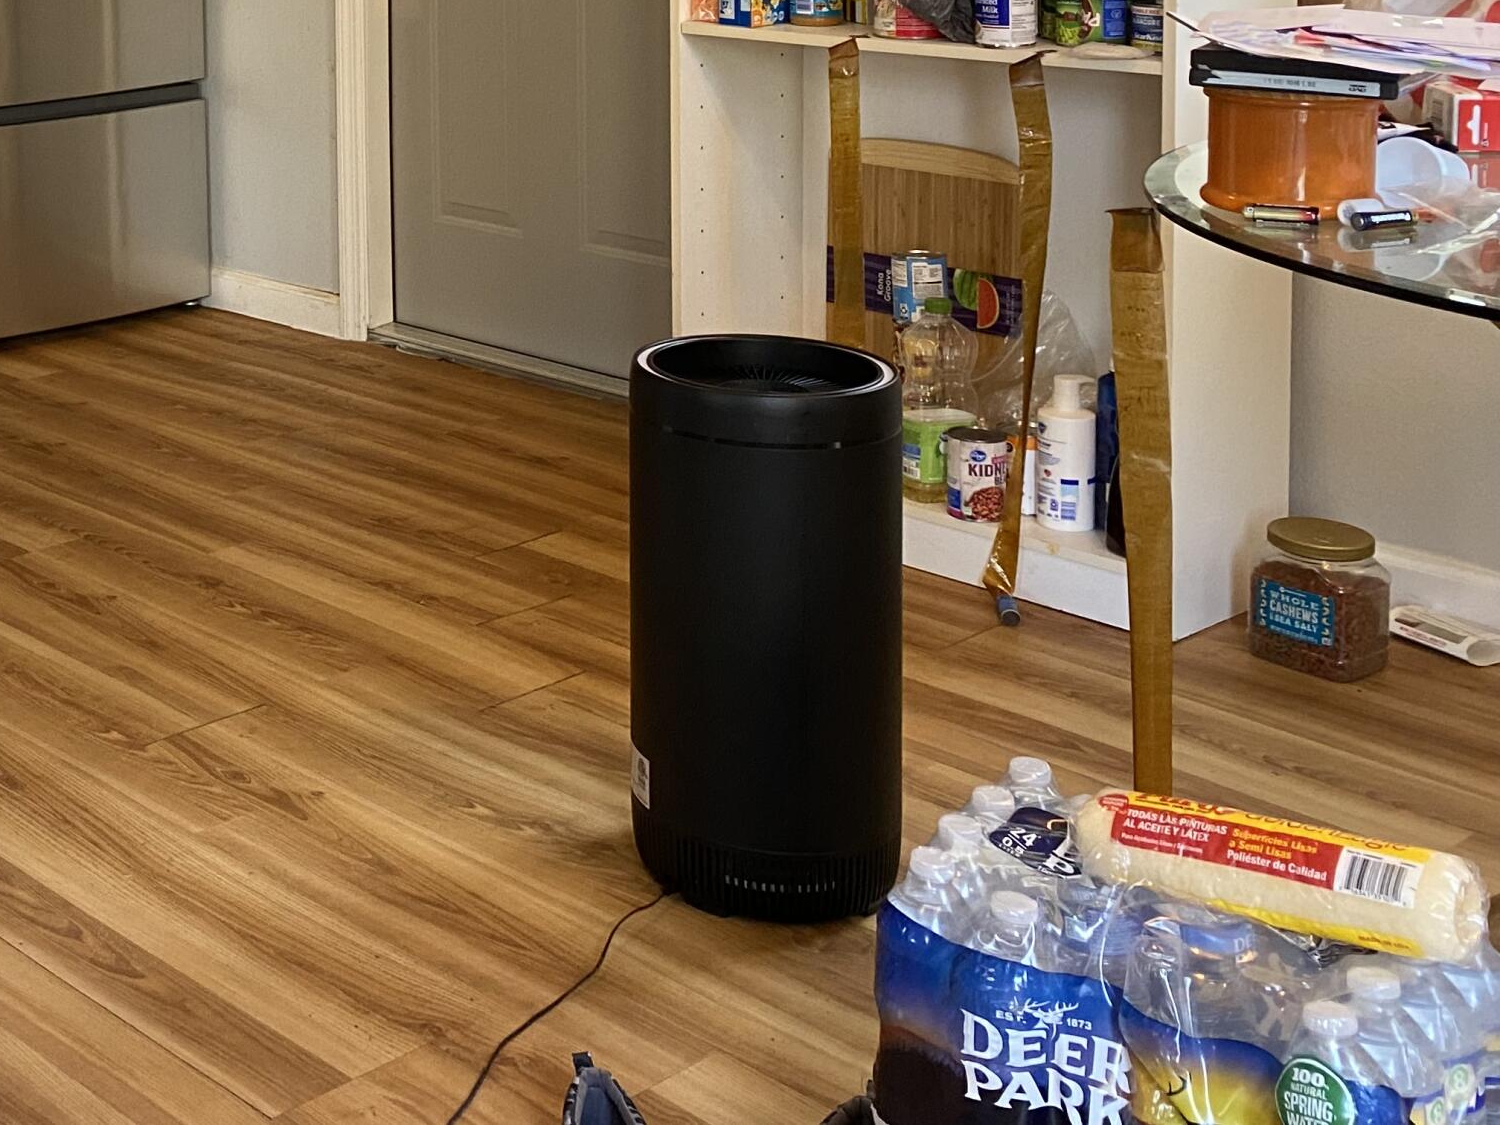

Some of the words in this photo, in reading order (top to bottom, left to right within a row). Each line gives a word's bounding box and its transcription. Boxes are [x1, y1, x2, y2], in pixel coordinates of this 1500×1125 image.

[982, 5, 998, 14] Milk
[876, 272, 884, 295] Kona
[884, 269, 892, 302] Groove
[1269, 590, 1320, 611] WHOLE
[1270, 600, 1319, 624] CASHEWS
[1275, 613, 1292, 626] SEA
[1294, 620, 1318, 633] SALT
[1123, 817, 1136, 828] AL
[1137, 820, 1171, 837] ACEITE
[1172, 826, 1179, 836] Y
[1180, 825, 1210, 843] LÁTEX
[1126, 808, 1157, 822] TODAS
[1159, 813, 1177, 825] LAS
[1179, 816, 1228, 835] PINTURAS
[1010, 827, 1037, 847] 24
[1232, 828, 1289, 847] Superficies
[1291, 841, 1318, 854] Lisas
[1239, 840, 1263, 853] Semi
[1265, 847, 1293, 860] Lisas
[1227, 849, 1271, 868] Poliéster
[1273, 860, 1286, 872] de
[1288, 864, 1327, 881] Calidad
[1067, 1018, 1092, 1031] 1873
[960, 1008, 1132, 1096] DEER
[960, 1060, 1132, 1125] PARK
[1290, 1082, 1327, 1099] NATURAL
[1284, 1092, 1333, 1121] SPRING
